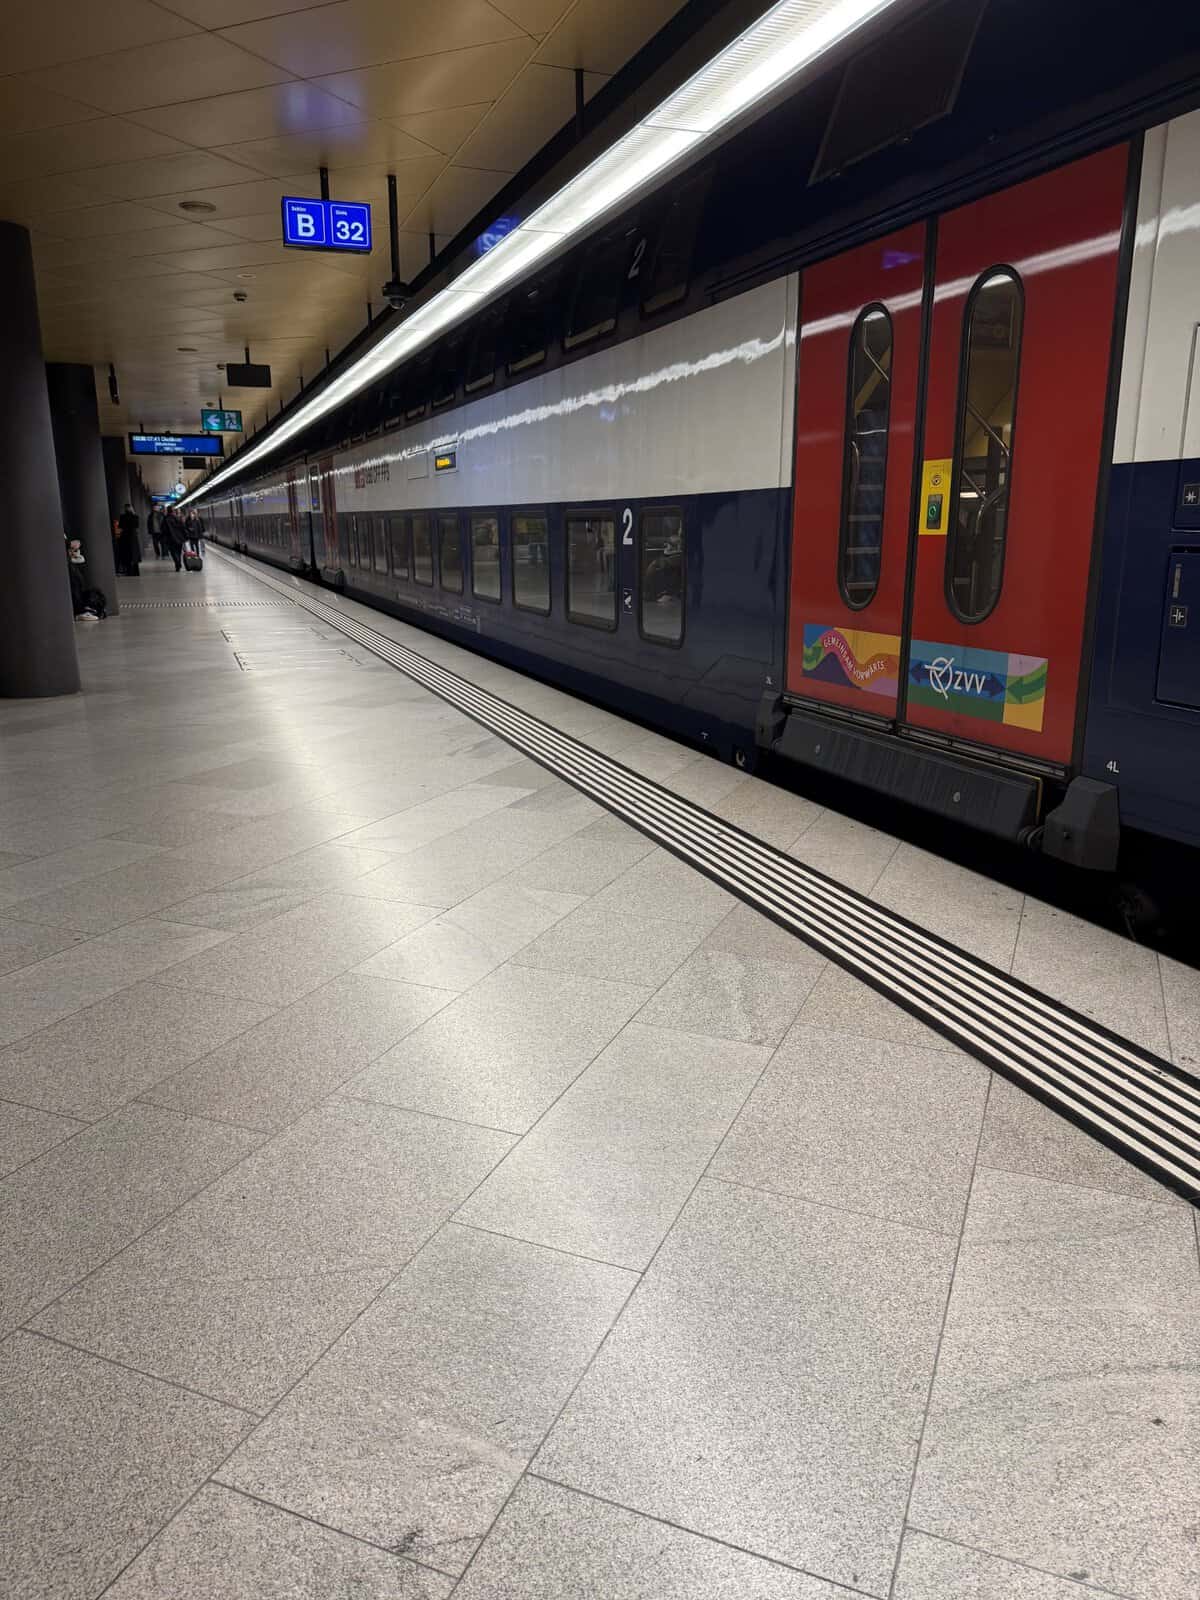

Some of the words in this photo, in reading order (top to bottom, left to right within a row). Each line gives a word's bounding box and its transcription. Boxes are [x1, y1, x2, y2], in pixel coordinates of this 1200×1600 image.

[297, 213, 315, 237] B
[336, 220, 364, 241] 32
[627, 238, 648, 280] 2
[622, 508, 633, 545] 2
[953, 670, 986, 694] ZVV
[1106, 760, 1120, 773] 4L
